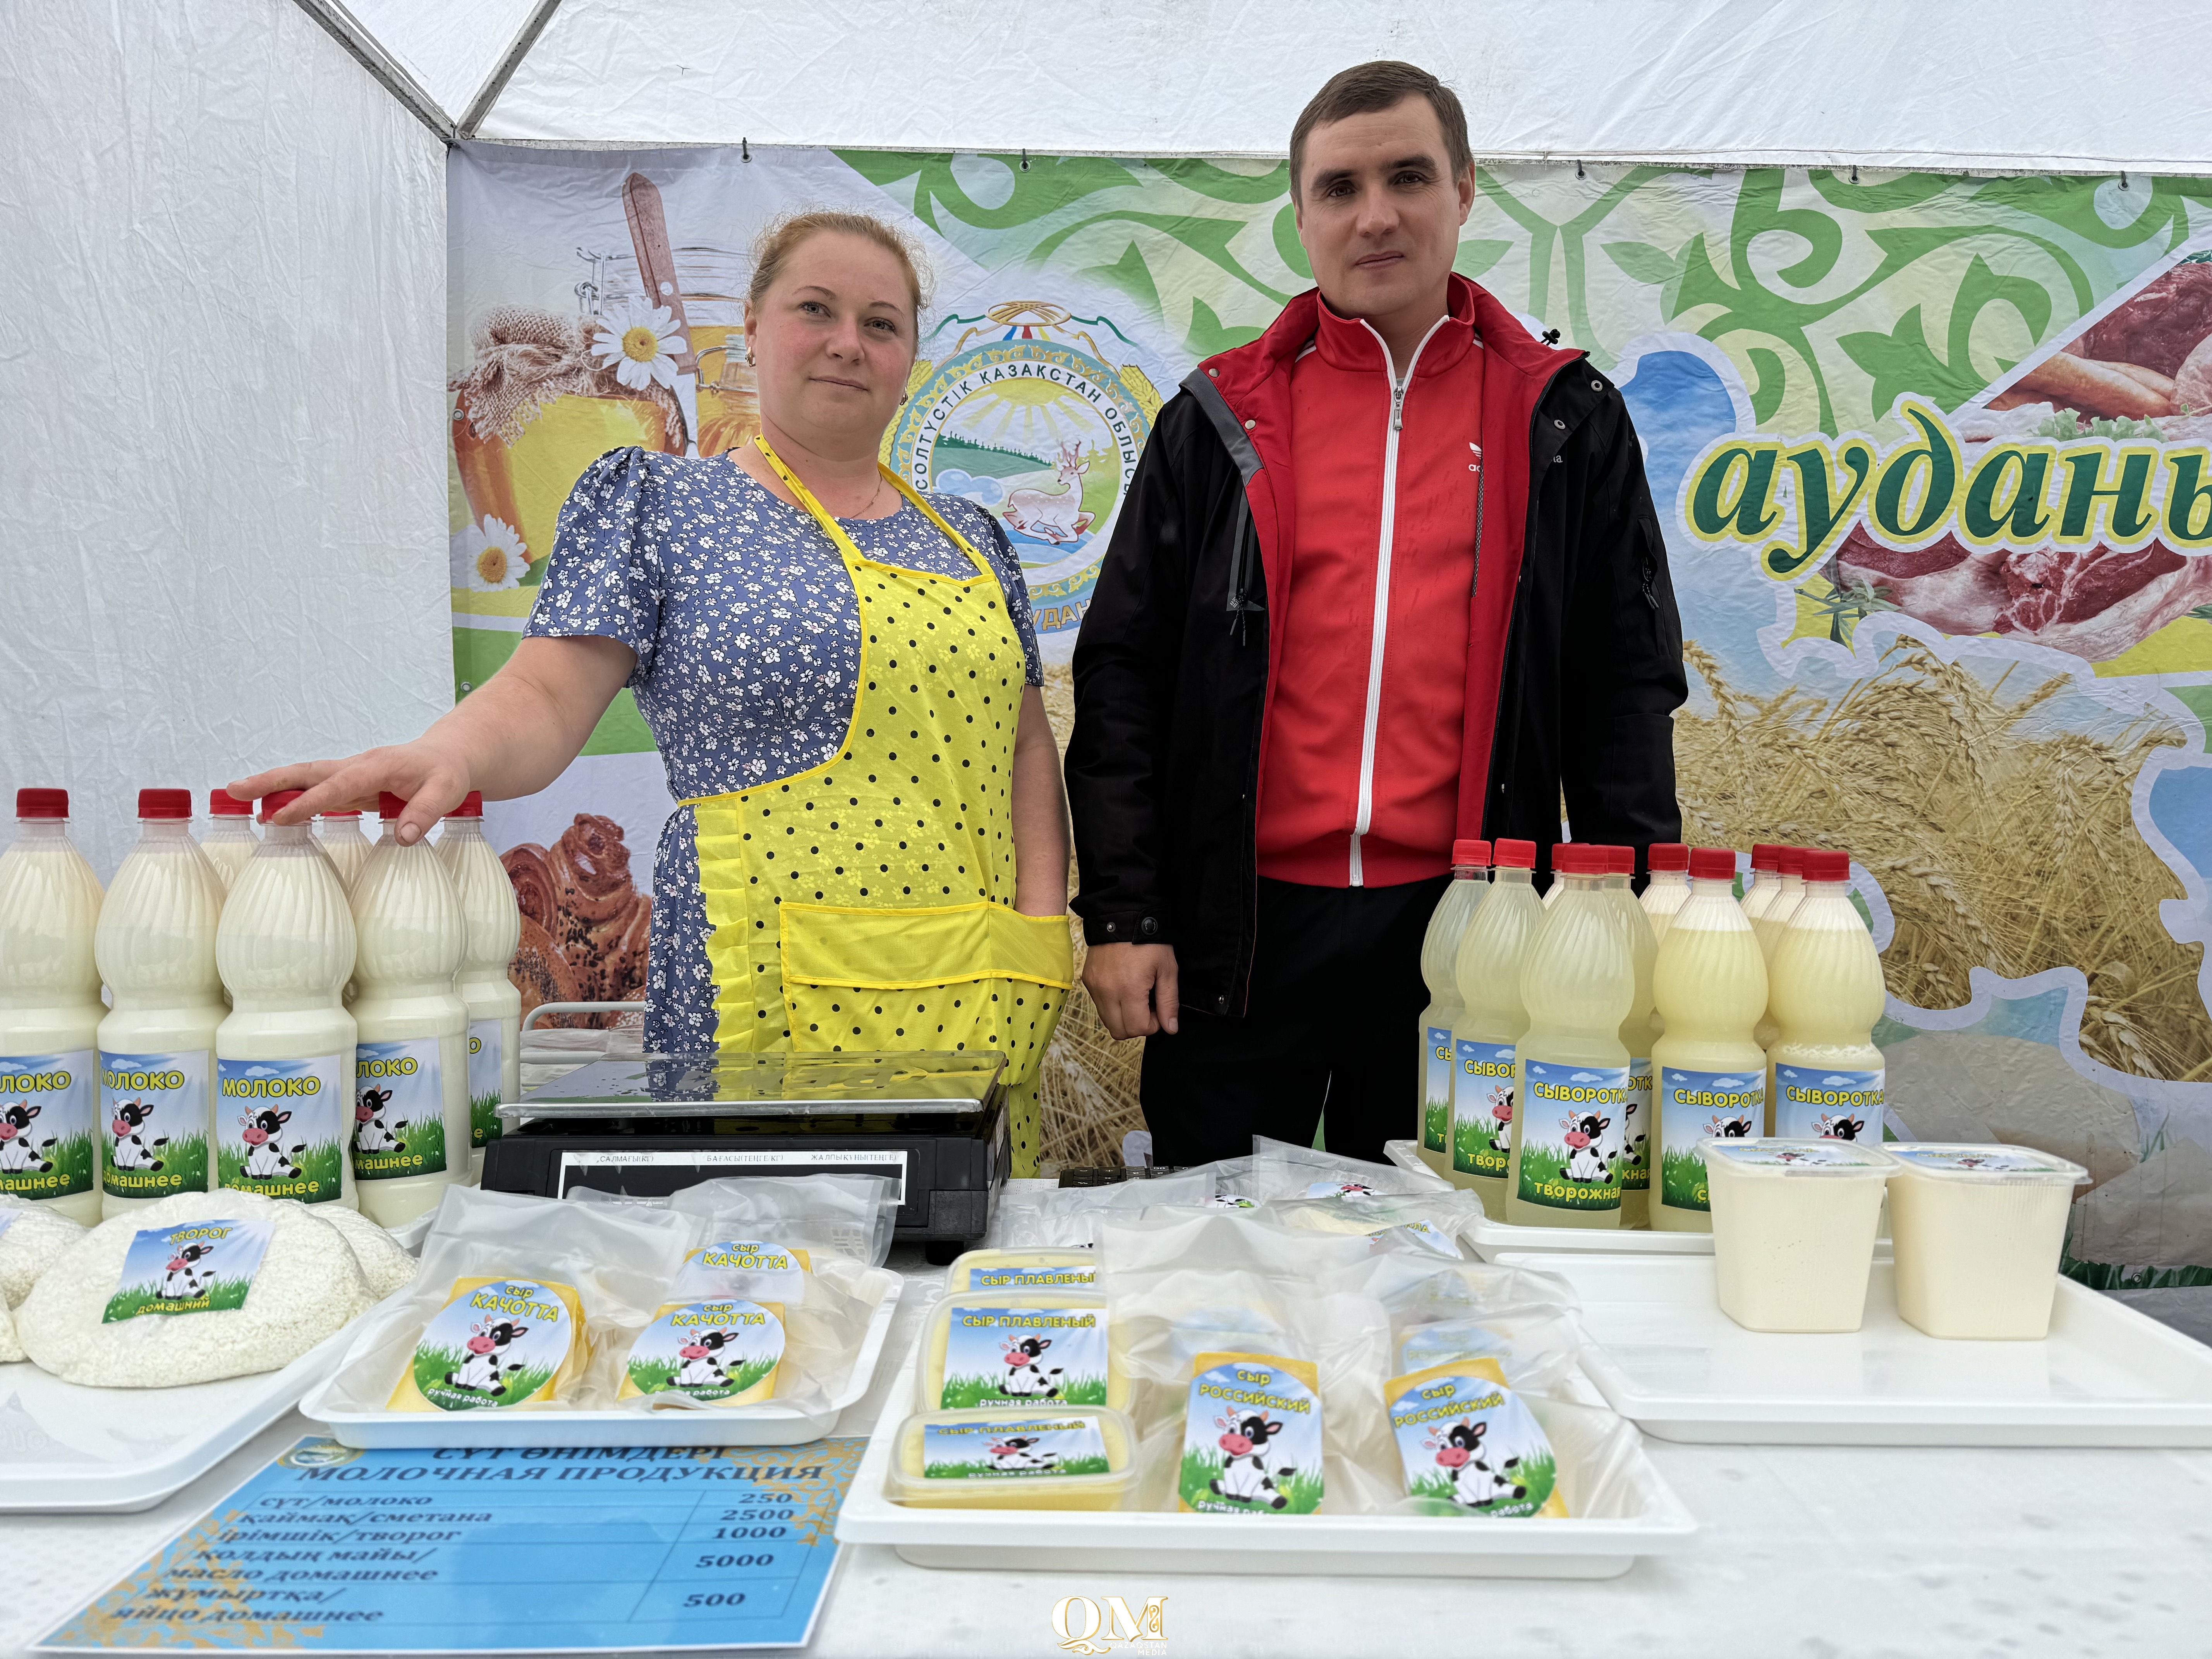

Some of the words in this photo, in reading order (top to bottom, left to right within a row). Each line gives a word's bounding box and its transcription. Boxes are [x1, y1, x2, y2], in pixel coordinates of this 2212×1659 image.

[915, 380, 972, 490] СОЛТҮСТІК
[979, 363, 1101, 403] ҚАЗАҚСТАН
[356, 1057, 418, 1078] ЛОКО
[1465, 1059, 1516, 1078] СЫВОР
[0, 1071, 71, 1093] ЛОКО
[102, 1066, 185, 1091] МОЛОКО
[222, 1076, 321, 1098] МОЛОКО
[1674, 1087, 1764, 1108] СЫВОРОТКА
[1786, 1085, 1884, 1106] СЫВОРОТКА
[355, 1154, 423, 1170] машнее
[0, 1174, 70, 1191] ашнее
[1534, 1182, 1621, 1202] творожная
[170, 1227, 233, 1245] ТВОРОГ
[732, 1243, 759, 1254] сыр
[702, 1252, 788, 1269] КАЧОТТА
[981, 1275, 1011, 1286] СЫР
[505, 1285, 534, 1300] сыр
[136, 1295, 211, 1315] домашний
[470, 1293, 559, 1322] КАЧОТТА
[703, 1304, 733, 1313] сыр
[671, 1313, 766, 1326] КАЧОТТА
[962, 1315, 994, 1327] СЫР
[999, 1314, 1096, 1328] ПЛАВЛЕНЫЙ
[1237, 1369, 1271, 1387] сыр
[1199, 1383, 1311, 1414] РОССИЙСКИЙ
[1421, 1384, 1456, 1400] сыр
[462, 1395, 499, 1408] работа
[1394, 1391, 1506, 1428] РОССИЙСКИЙ
[938, 1426, 974, 1436] СЫР
[295, 1467, 551, 1481] МОЛОЧНАЯ
[555, 1466, 826, 1482] ПРОДУКЦИЯ
[738, 1493, 793, 1504] 250
[720, 1509, 794, 1521] 2500
[712, 1526, 787, 1539] 1000
[694, 1553, 774, 1568] 5000
[264, 1568, 439, 1583] домашнее
[682, 1592, 746, 1607] 500
